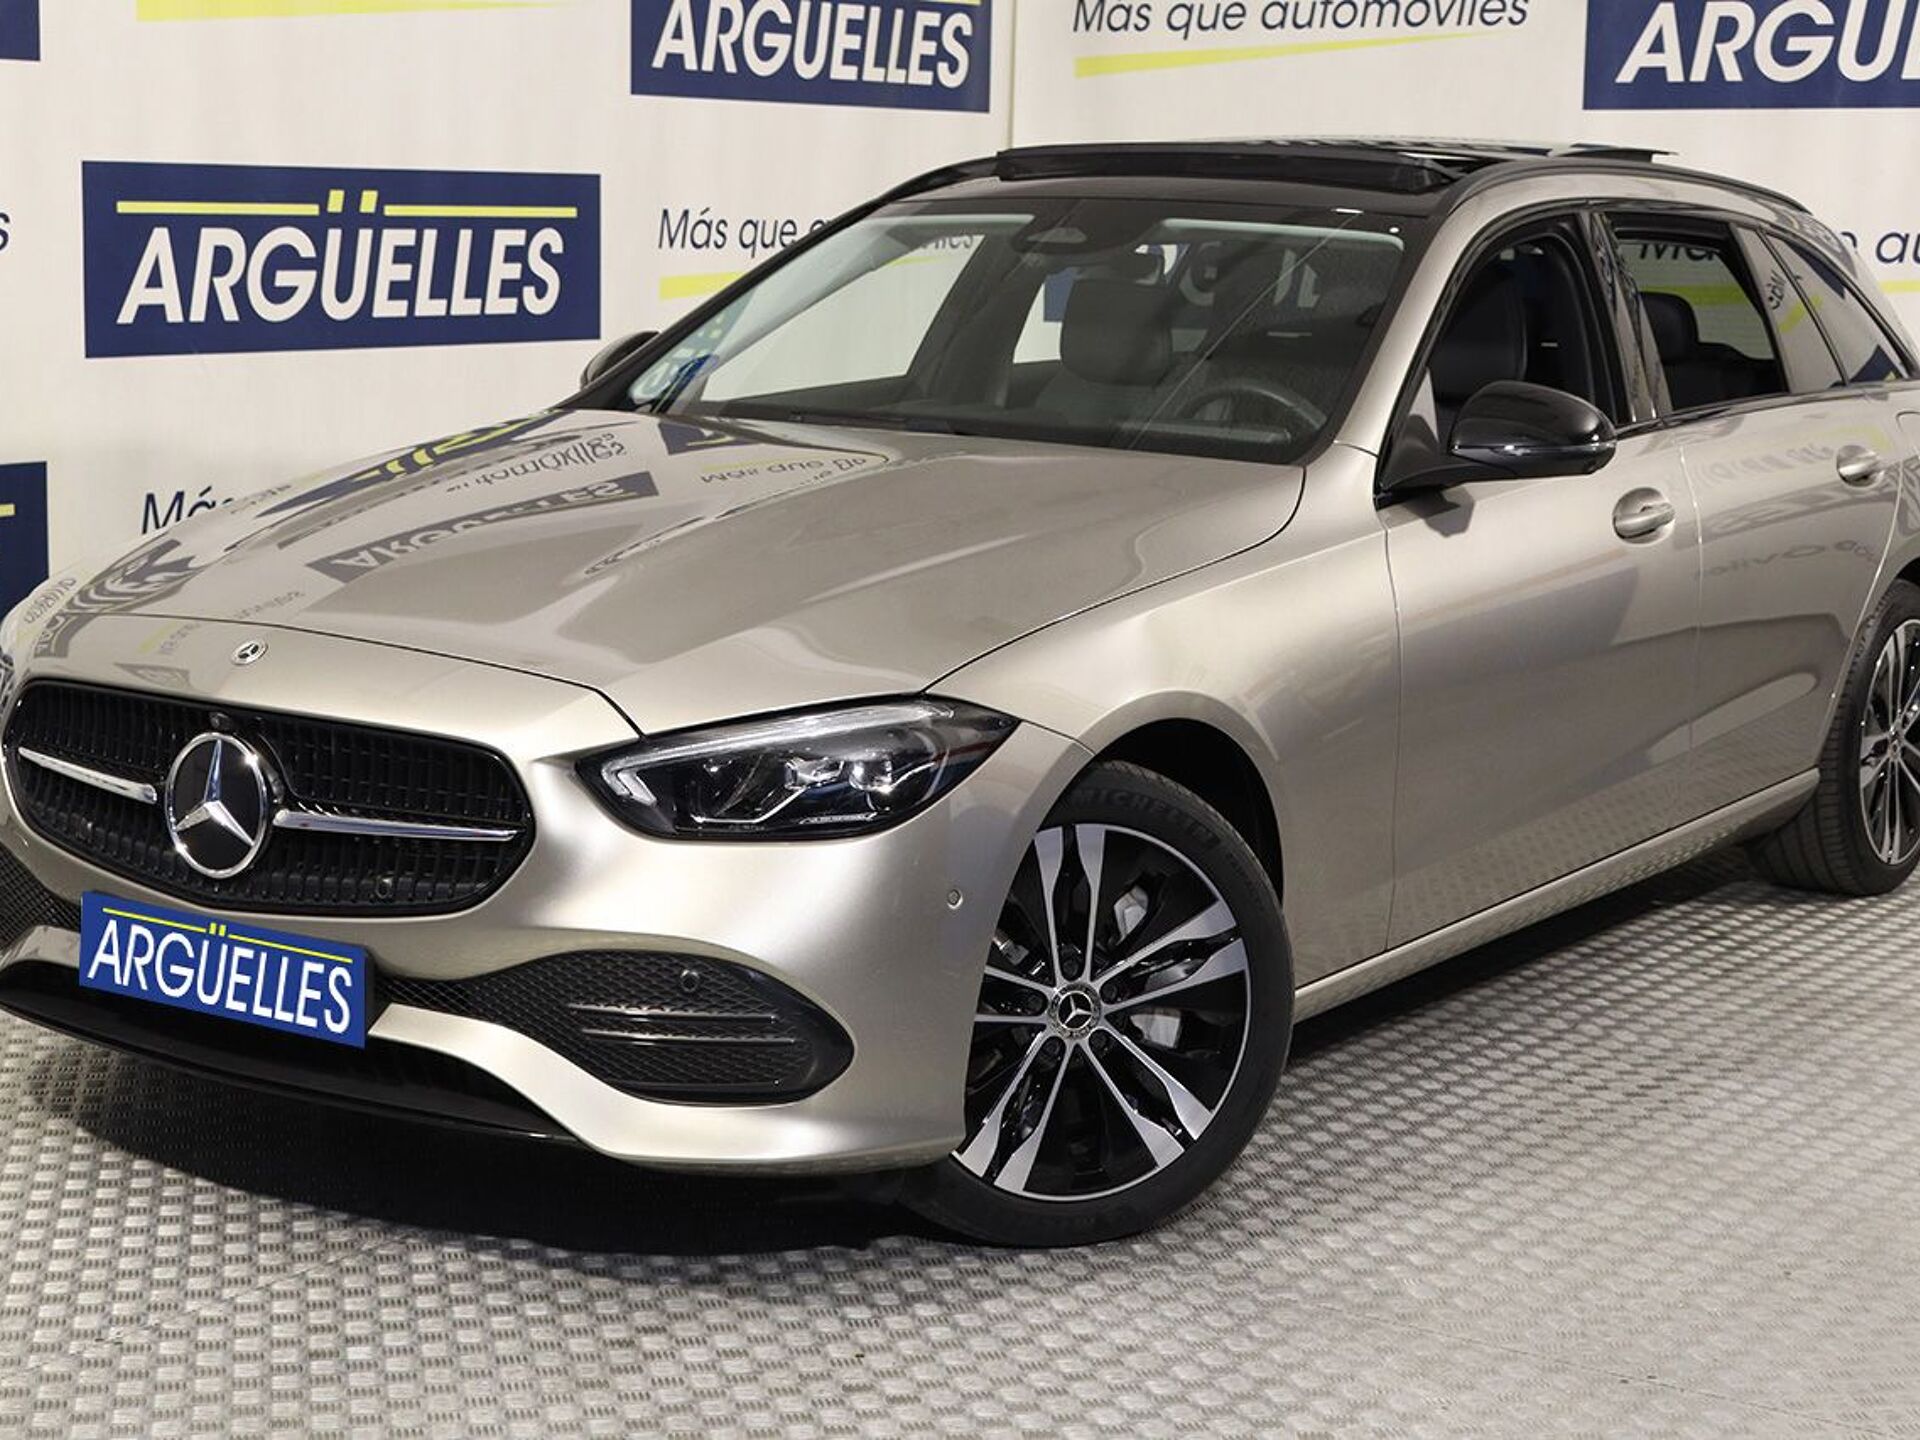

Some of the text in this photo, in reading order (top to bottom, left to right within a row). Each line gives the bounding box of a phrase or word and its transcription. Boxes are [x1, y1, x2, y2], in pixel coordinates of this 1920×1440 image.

[1166, 0, 1247, 40] que
[116, 190, 565, 325] ARGÜELLES
[657, 206, 728, 250] Más
[738, 218, 798, 258] que
[87, 919, 353, 1034] ARGÜELLES
